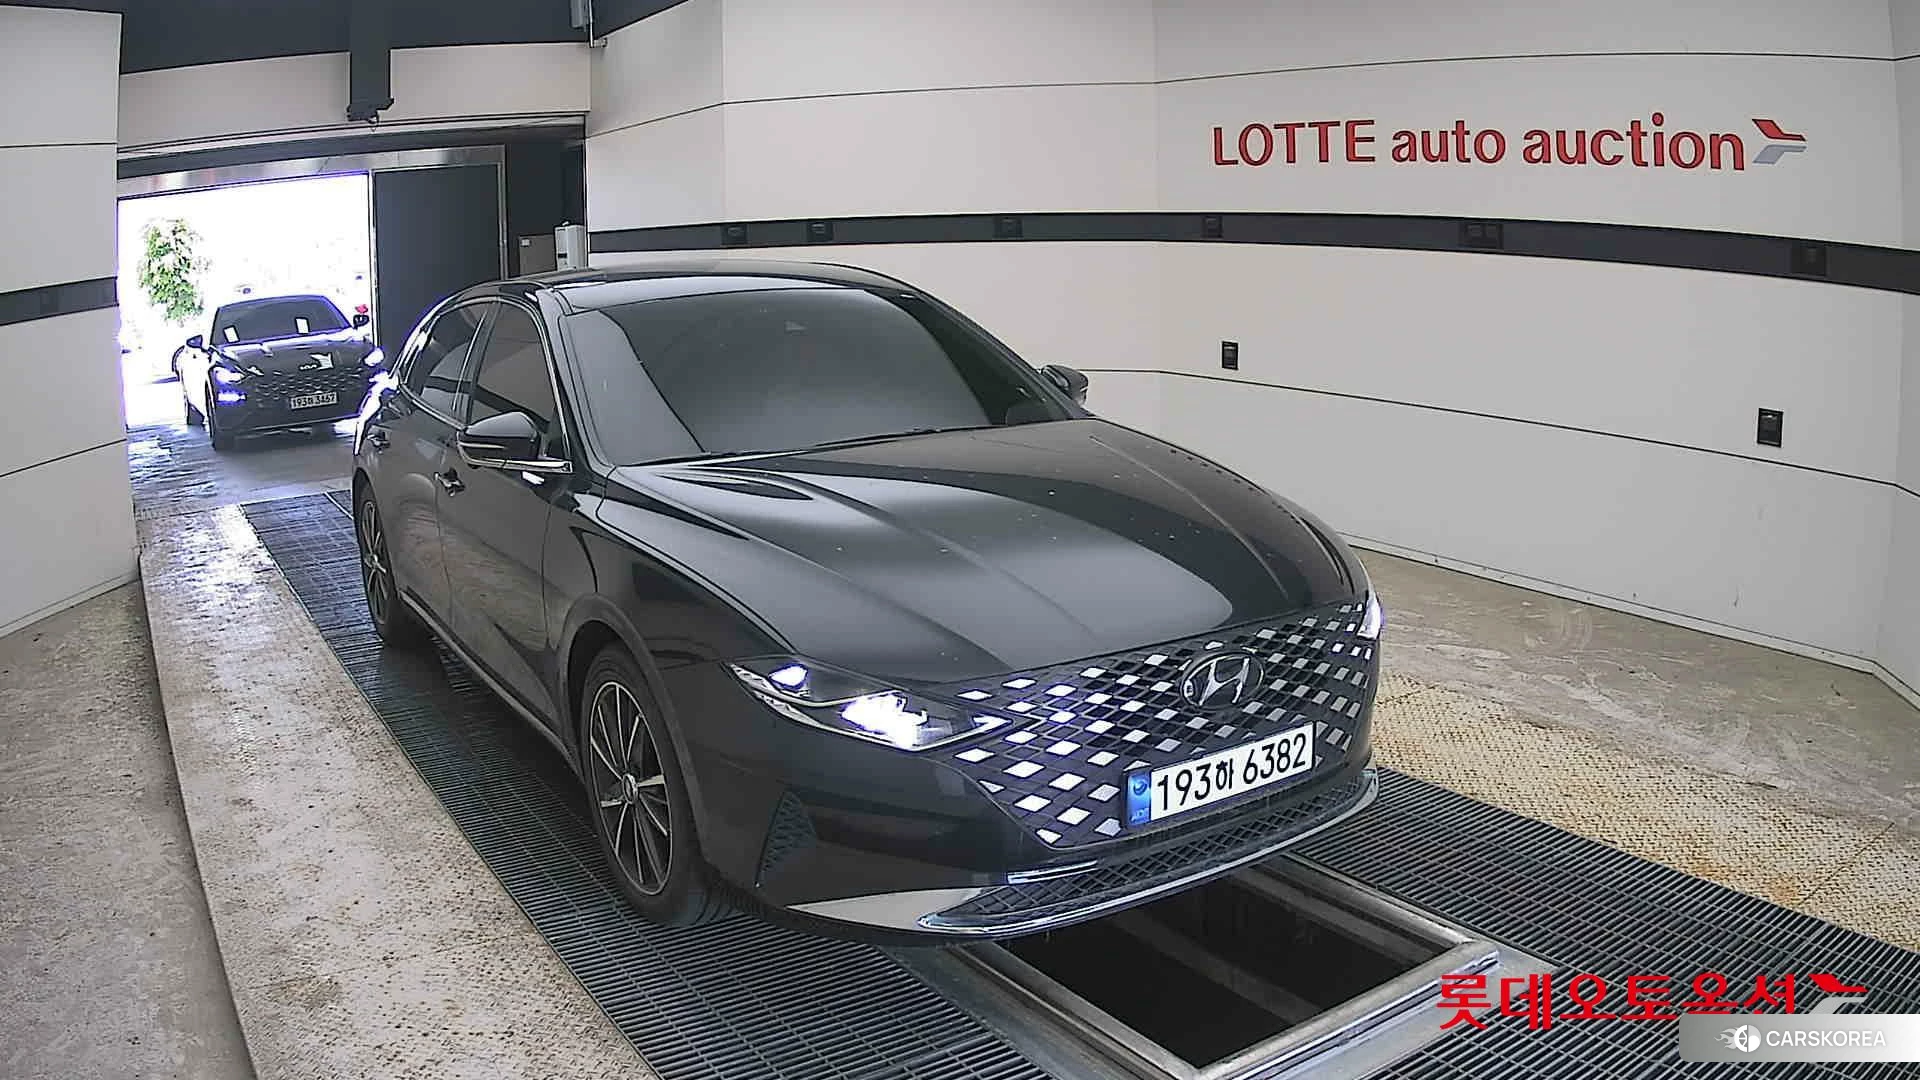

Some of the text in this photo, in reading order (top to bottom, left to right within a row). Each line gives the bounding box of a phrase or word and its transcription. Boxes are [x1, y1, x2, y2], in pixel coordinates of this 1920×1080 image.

[1212, 111, 1745, 171] LOTTE auto auction
[1157, 733, 1307, 811] 193하 6382
